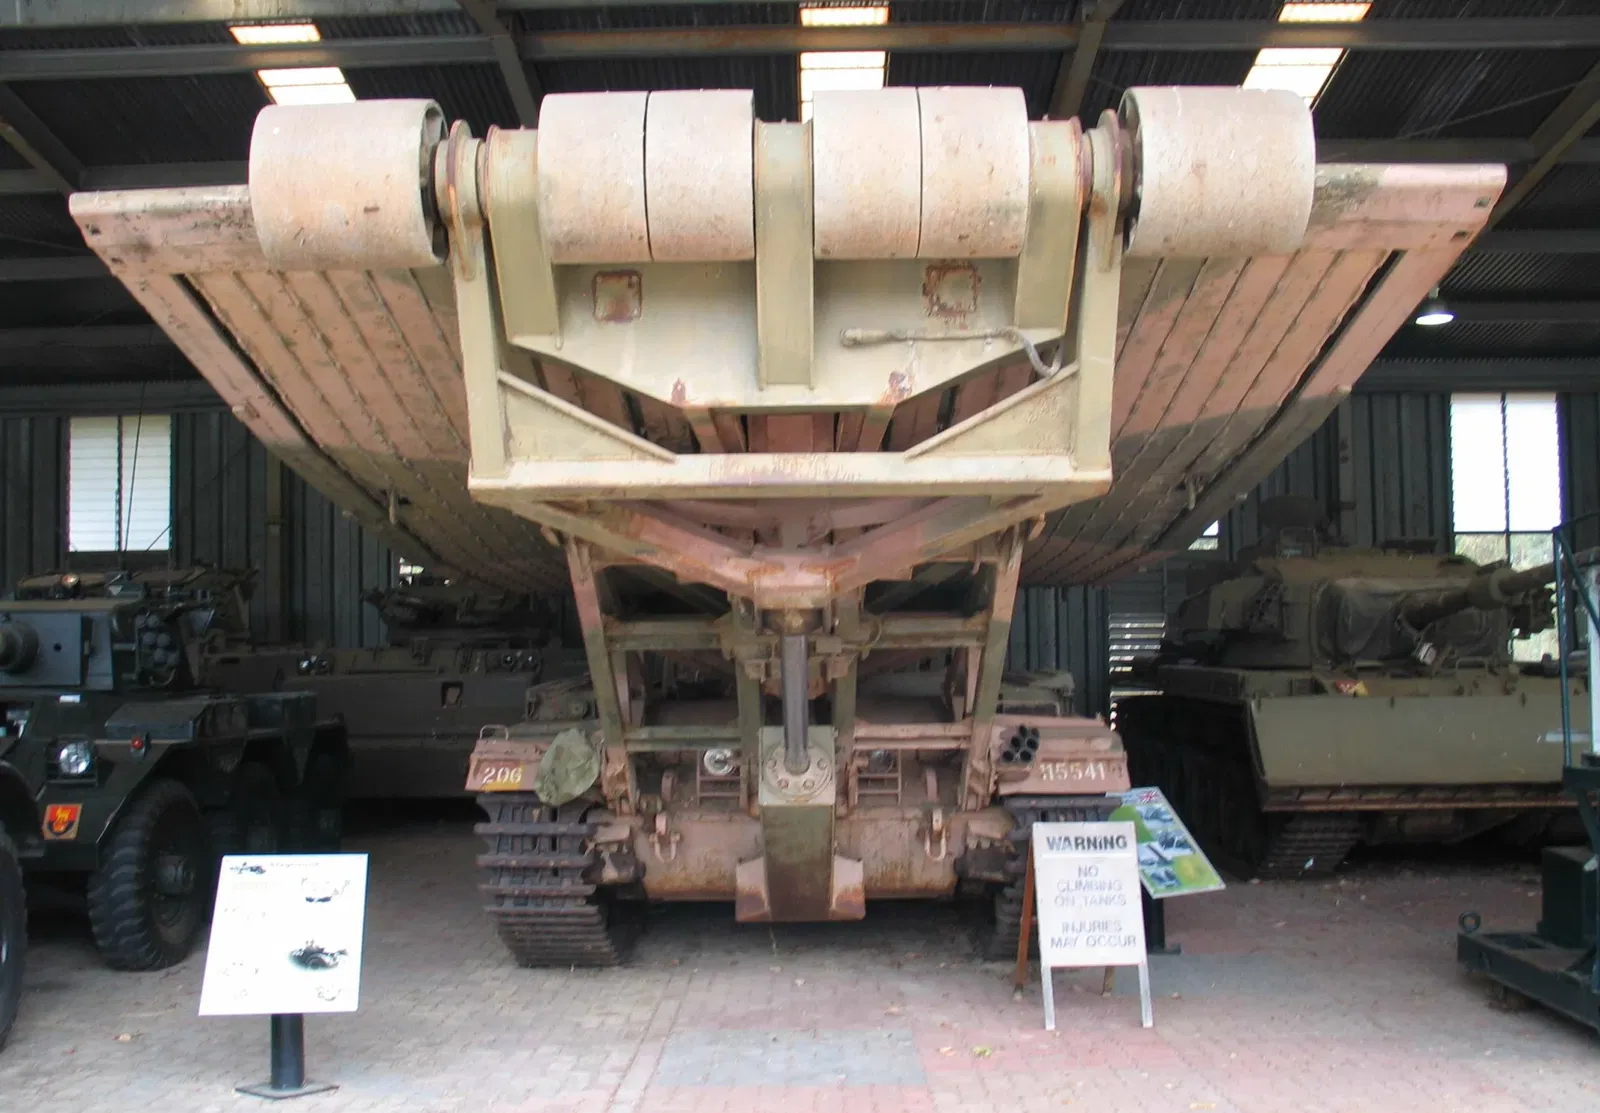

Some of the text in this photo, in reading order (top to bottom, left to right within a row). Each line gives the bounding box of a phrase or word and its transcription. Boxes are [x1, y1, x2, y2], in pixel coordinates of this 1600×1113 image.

[482, 766, 522, 784] 206
[1040, 762, 1105, 781] 115541
[1046, 834, 1127, 851] WARNING
[1078, 865, 1099, 878] NO
[1057, 880, 1122, 892] CLIMBING
[1054, 894, 1127, 906] ON TANKS
[1062, 920, 1122, 933] INJURIES
[1050, 934, 1136, 949] MAY OCCUR
